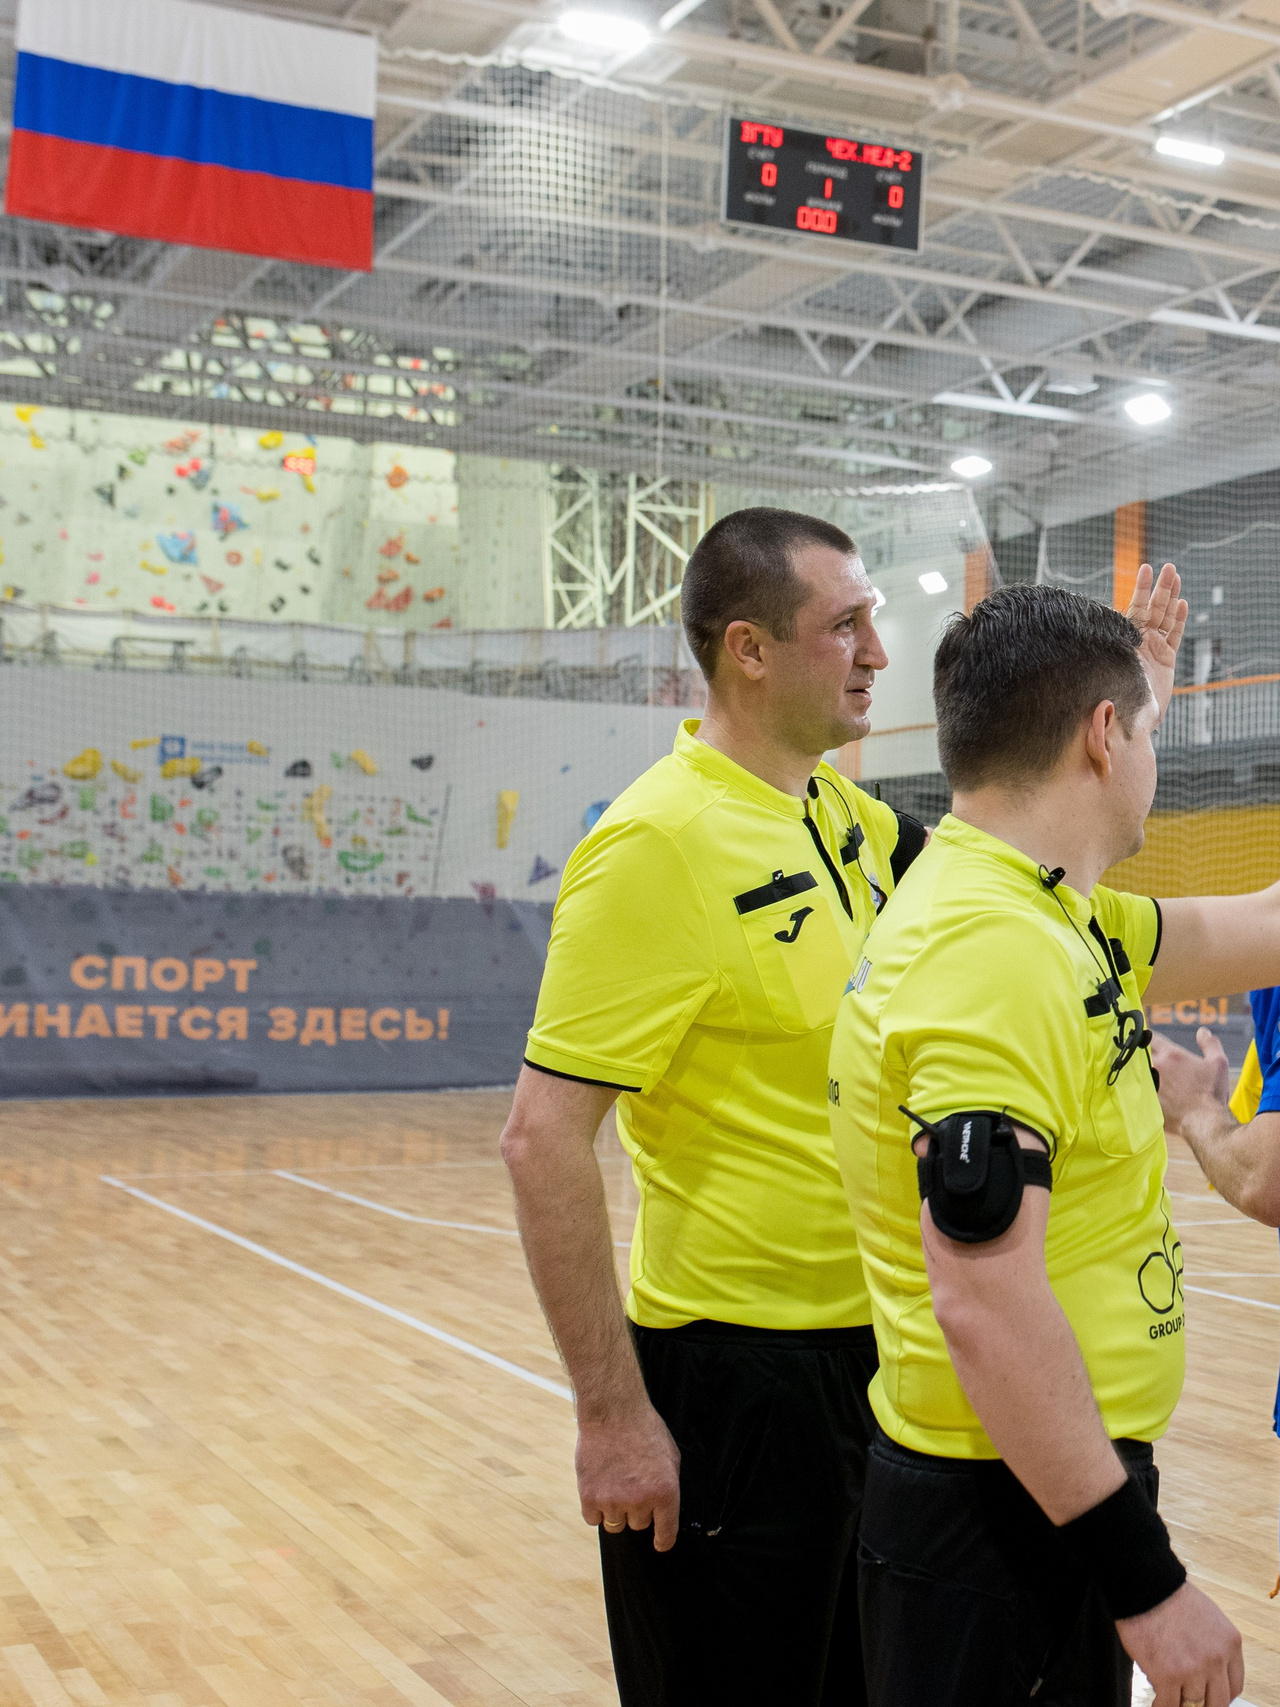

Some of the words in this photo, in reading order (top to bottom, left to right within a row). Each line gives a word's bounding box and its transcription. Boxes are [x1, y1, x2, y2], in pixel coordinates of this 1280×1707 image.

[761, 163, 777, 187] 0
[824, 178, 833, 199] 1
[888, 185, 904, 208] 0
[796, 206, 837, 233] 000
[70, 955, 257, 992] СПОРТ
[1150, 998, 1228, 1025] ЕСЬ!
[0, 1003, 248, 1040] ИНАЕТСЯ
[267, 1006, 450, 1046] ЗДЕСЬ!
[1149, 1316, 1183, 1340] GROUP
